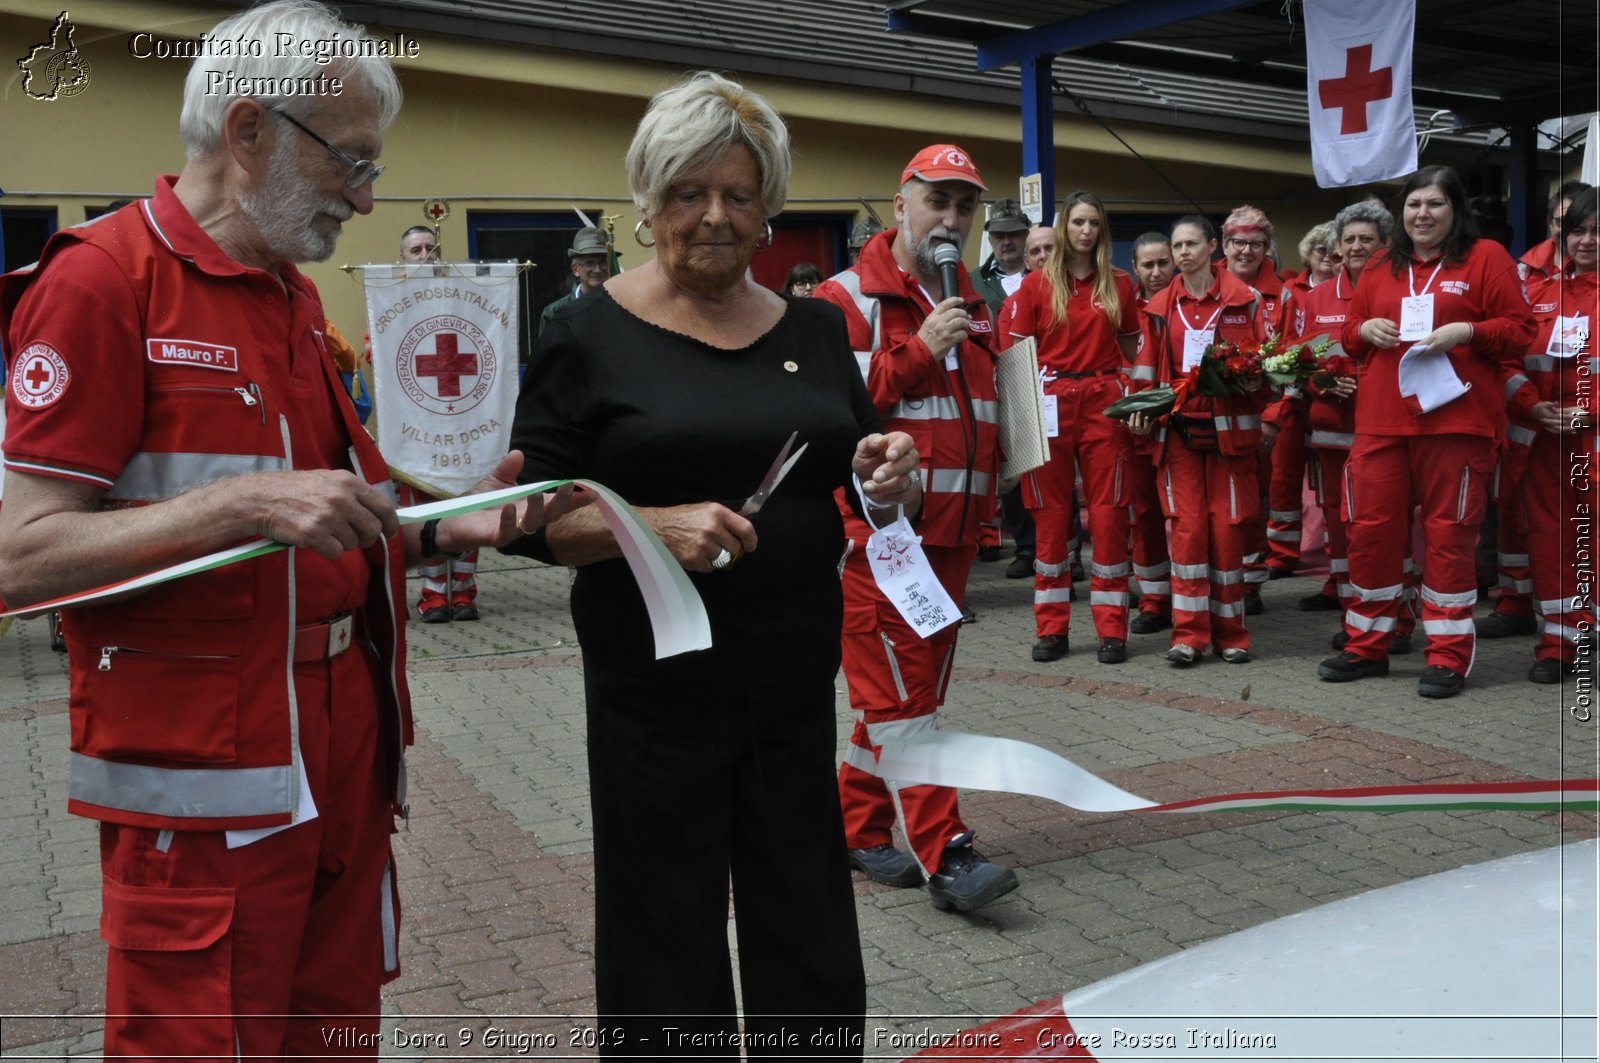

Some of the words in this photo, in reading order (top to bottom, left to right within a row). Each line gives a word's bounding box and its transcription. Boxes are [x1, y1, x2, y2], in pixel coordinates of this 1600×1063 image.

[376, 297, 412, 334] CROCE
[414, 288, 460, 304] ROSSA
[464, 291, 508, 329] ITALIANA
[415, 325, 426, 338] DI
[426, 317, 470, 335] GINEVRA
[470, 328, 481, 341] 22
[162, 343, 213, 363] Mauro
[215, 350, 228, 365] F.
[477, 338, 494, 381] AGOSTO
[398, 333, 425, 402] CONVENZIONE
[473, 382, 489, 401] 1864
[401, 422, 455, 446] VILLAR
[460, 418, 501, 445] DORA
[432, 452, 472, 467] 1989
